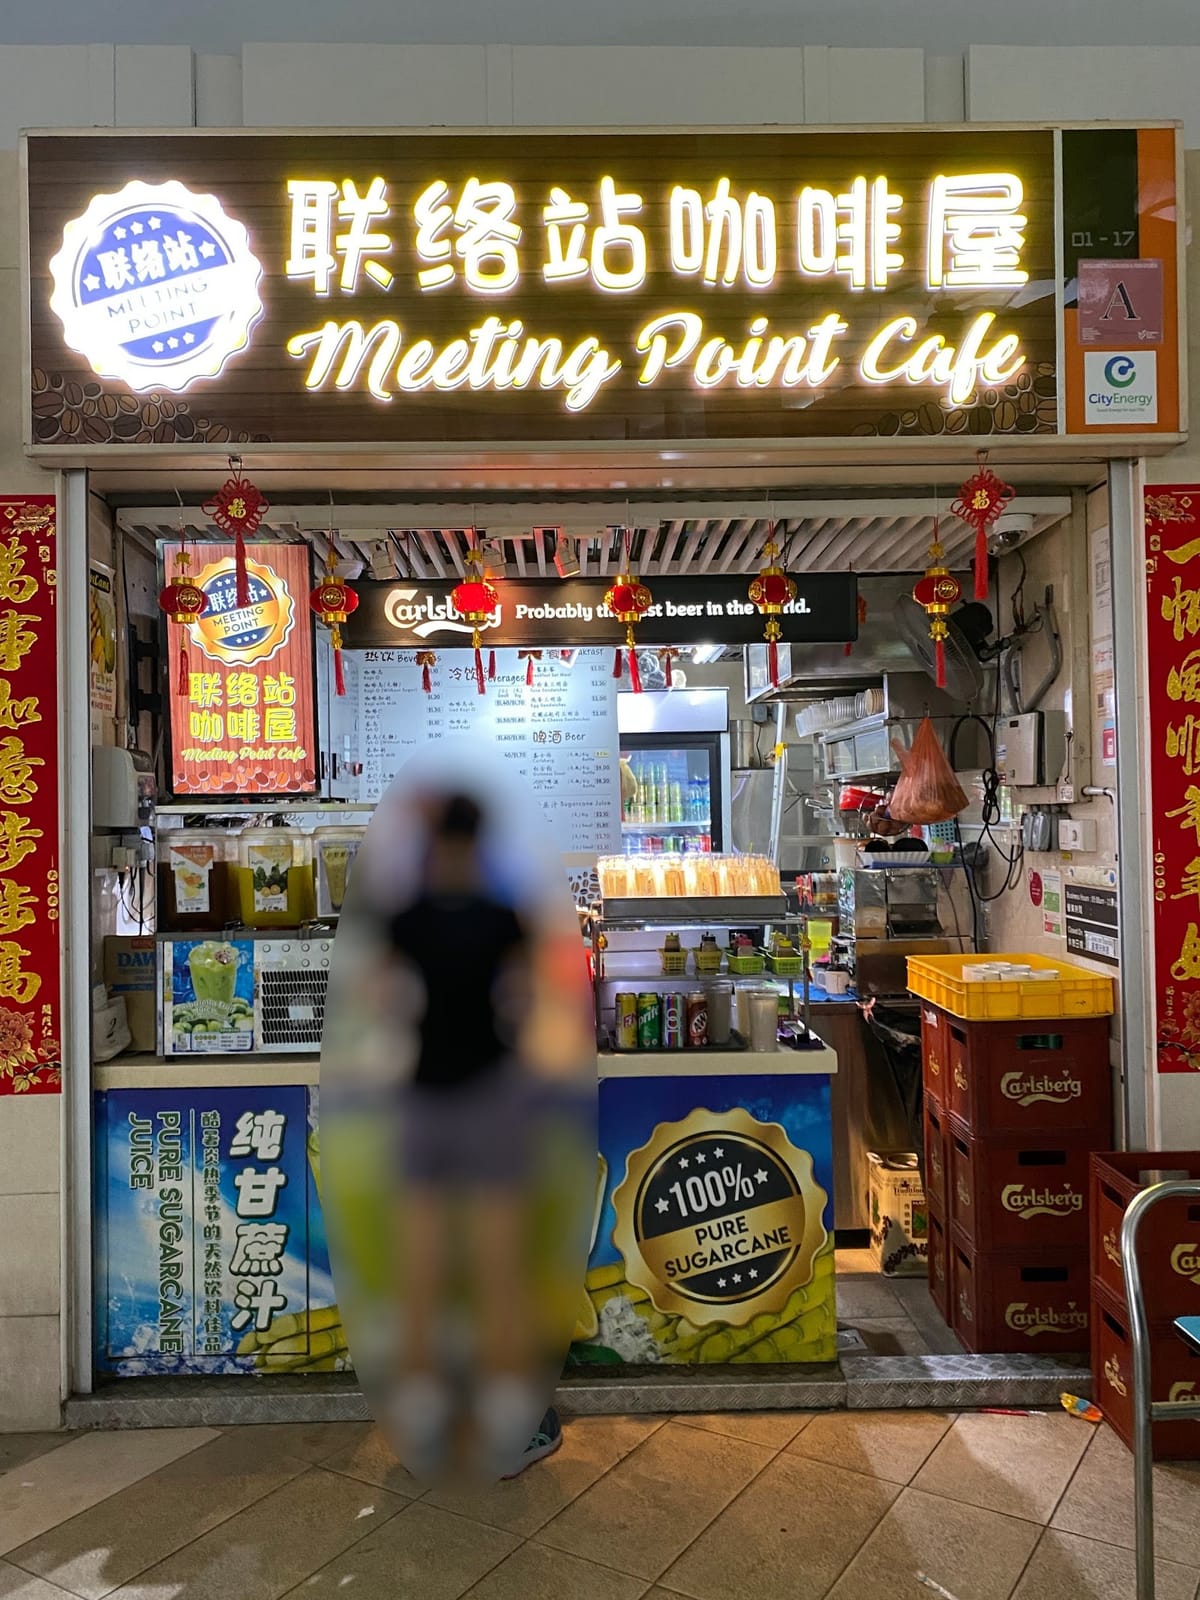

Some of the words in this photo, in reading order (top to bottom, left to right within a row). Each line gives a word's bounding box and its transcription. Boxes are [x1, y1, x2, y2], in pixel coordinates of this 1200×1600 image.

[286, 172, 1030, 293] 联络站咖啡屋
[97, 231, 202, 290] 联络站
[1099, 280, 1142, 320] A
[287, 316, 622, 411] Meeting
[636, 311, 848, 387] Point
[860, 311, 1027, 405] Cafe
[1088, 393, 1153, 407] CityEnergy
[213, 606, 264, 627] MEETING
[223, 618, 259, 635] POINT
[384, 589, 502, 630] Carlsbg
[515, 603, 593, 621] Probably
[666, 601, 703, 617] beer
[707, 601, 723, 616] in
[726, 600, 754, 615] the
[188, 671, 296, 707] 联络站
[189, 708, 299, 743] 咖啡屋
[533, 730, 562, 743] 啤酒
[565, 732, 586, 741] Beer
[181, 748, 237, 764] Meeting
[239, 747, 275, 761] Point
[275, 745, 307, 761] Cafe
[1000, 1070, 1082, 1103] Carlsberg
[129, 1112, 153, 1190] JUICE
[157, 1112, 182, 1181] PURE
[669, 1163, 755, 1217] 100%
[1001, 1184, 1083, 1217] Carlsberg
[201, 1110, 222, 1352] 酷暑炎热季节的天然饮料佳品
[230, 1110, 291, 1333] 纯甘蔗汁
[695, 1216, 749, 1245] PURE
[159, 1187, 184, 1354] SUGARCANE
[665, 1226, 792, 1278] SUGARCANE
[1005, 1302, 1088, 1333] Carlsberg
